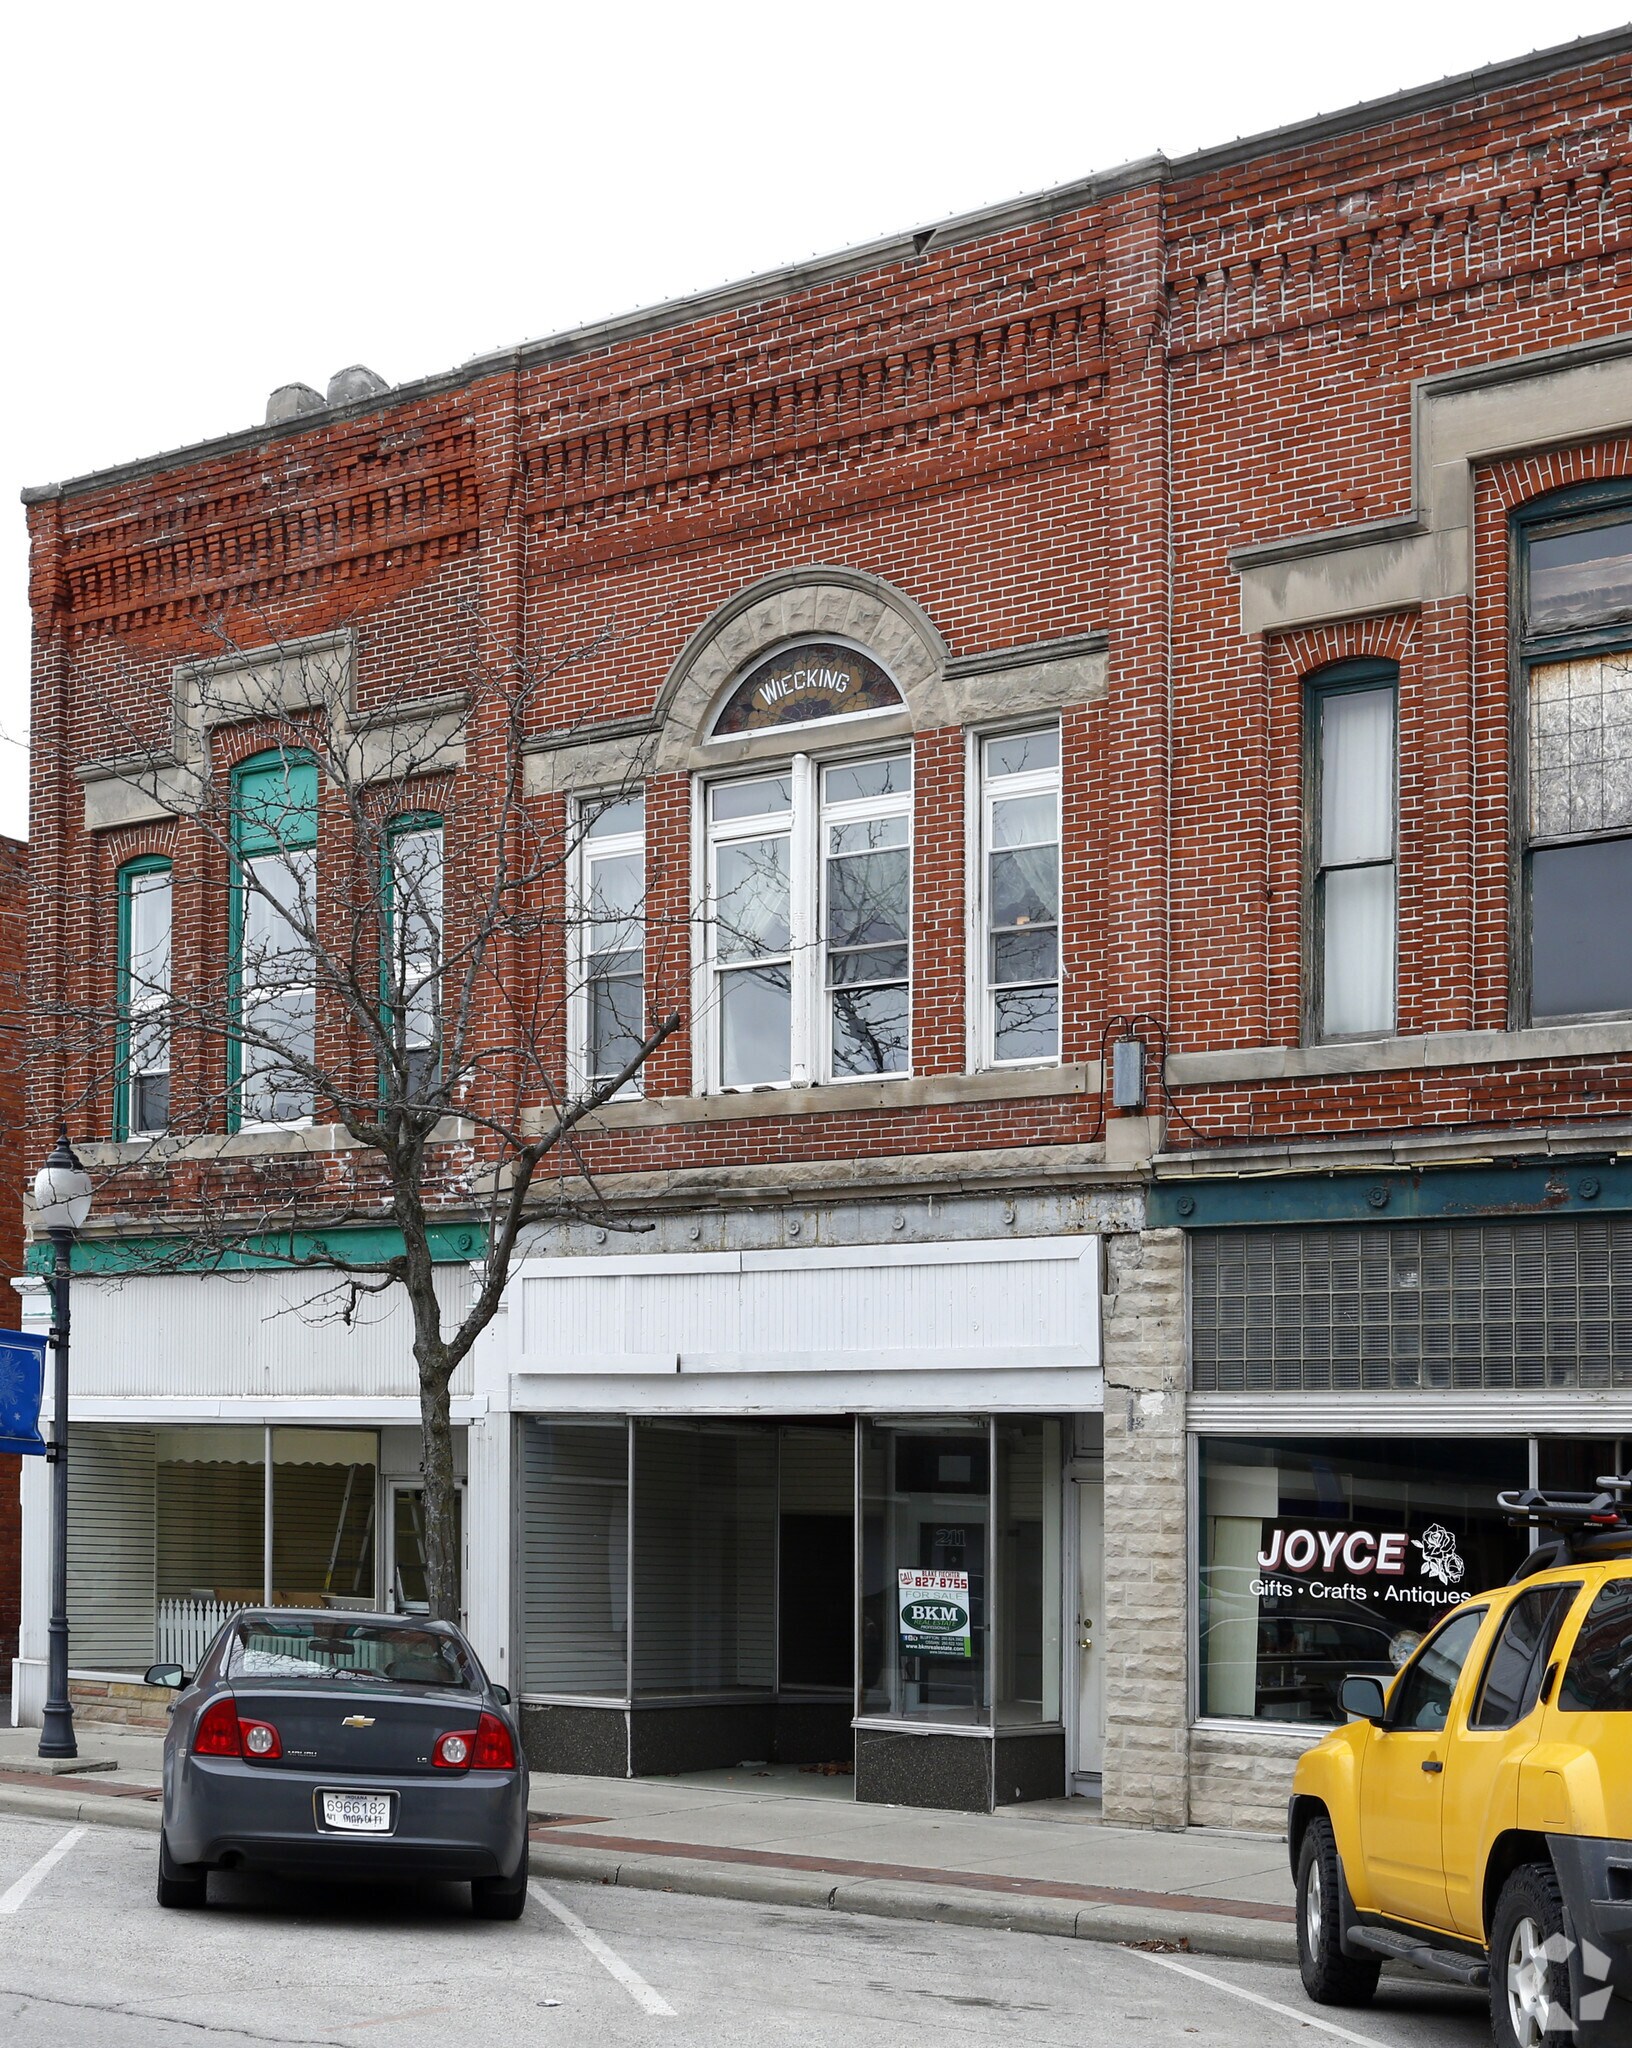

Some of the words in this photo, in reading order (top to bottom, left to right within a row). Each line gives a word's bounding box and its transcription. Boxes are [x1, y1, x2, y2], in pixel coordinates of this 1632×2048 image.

[759, 668, 850, 706] WIECKING
[936, 1529, 966, 1547] 211
[1257, 1529, 1409, 1575] JOYCE
[900, 1571, 913, 1582] CALL
[915, 1577, 967, 1589] 827-8755
[905, 1591, 929, 1599] FOR
[933, 1592, 963, 1601] SALE
[1249, 1579, 1293, 1597] Gifts
[1309, 1581, 1368, 1600] Crafts
[1384, 1585, 1472, 1607] Antiques
[911, 1605, 958, 1621] BKM
[327, 1800, 386, 1815] 6966182
